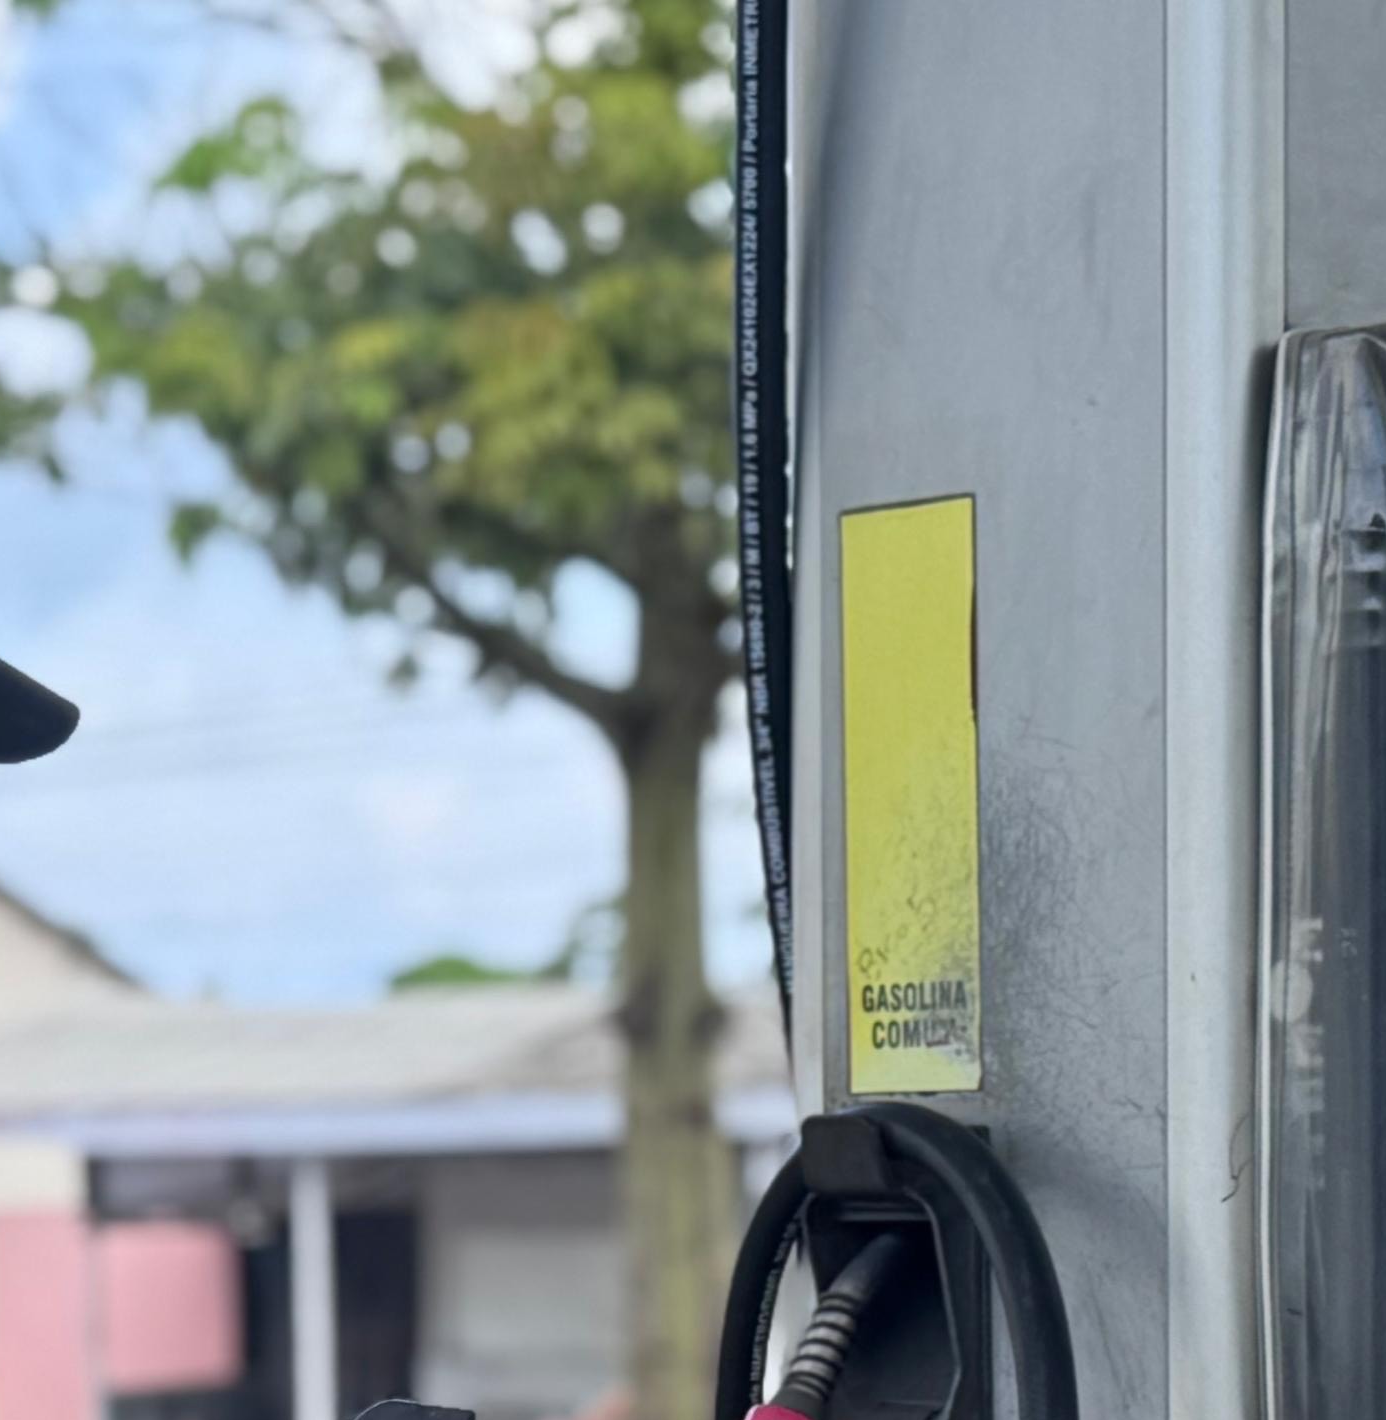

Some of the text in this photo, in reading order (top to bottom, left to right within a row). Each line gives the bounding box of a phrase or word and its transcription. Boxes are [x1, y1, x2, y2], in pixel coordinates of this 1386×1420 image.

[741, 0, 760, 75] INMETR
[742, 79, 759, 153] Portaria
[862, 981, 967, 1013] GASOLINA
